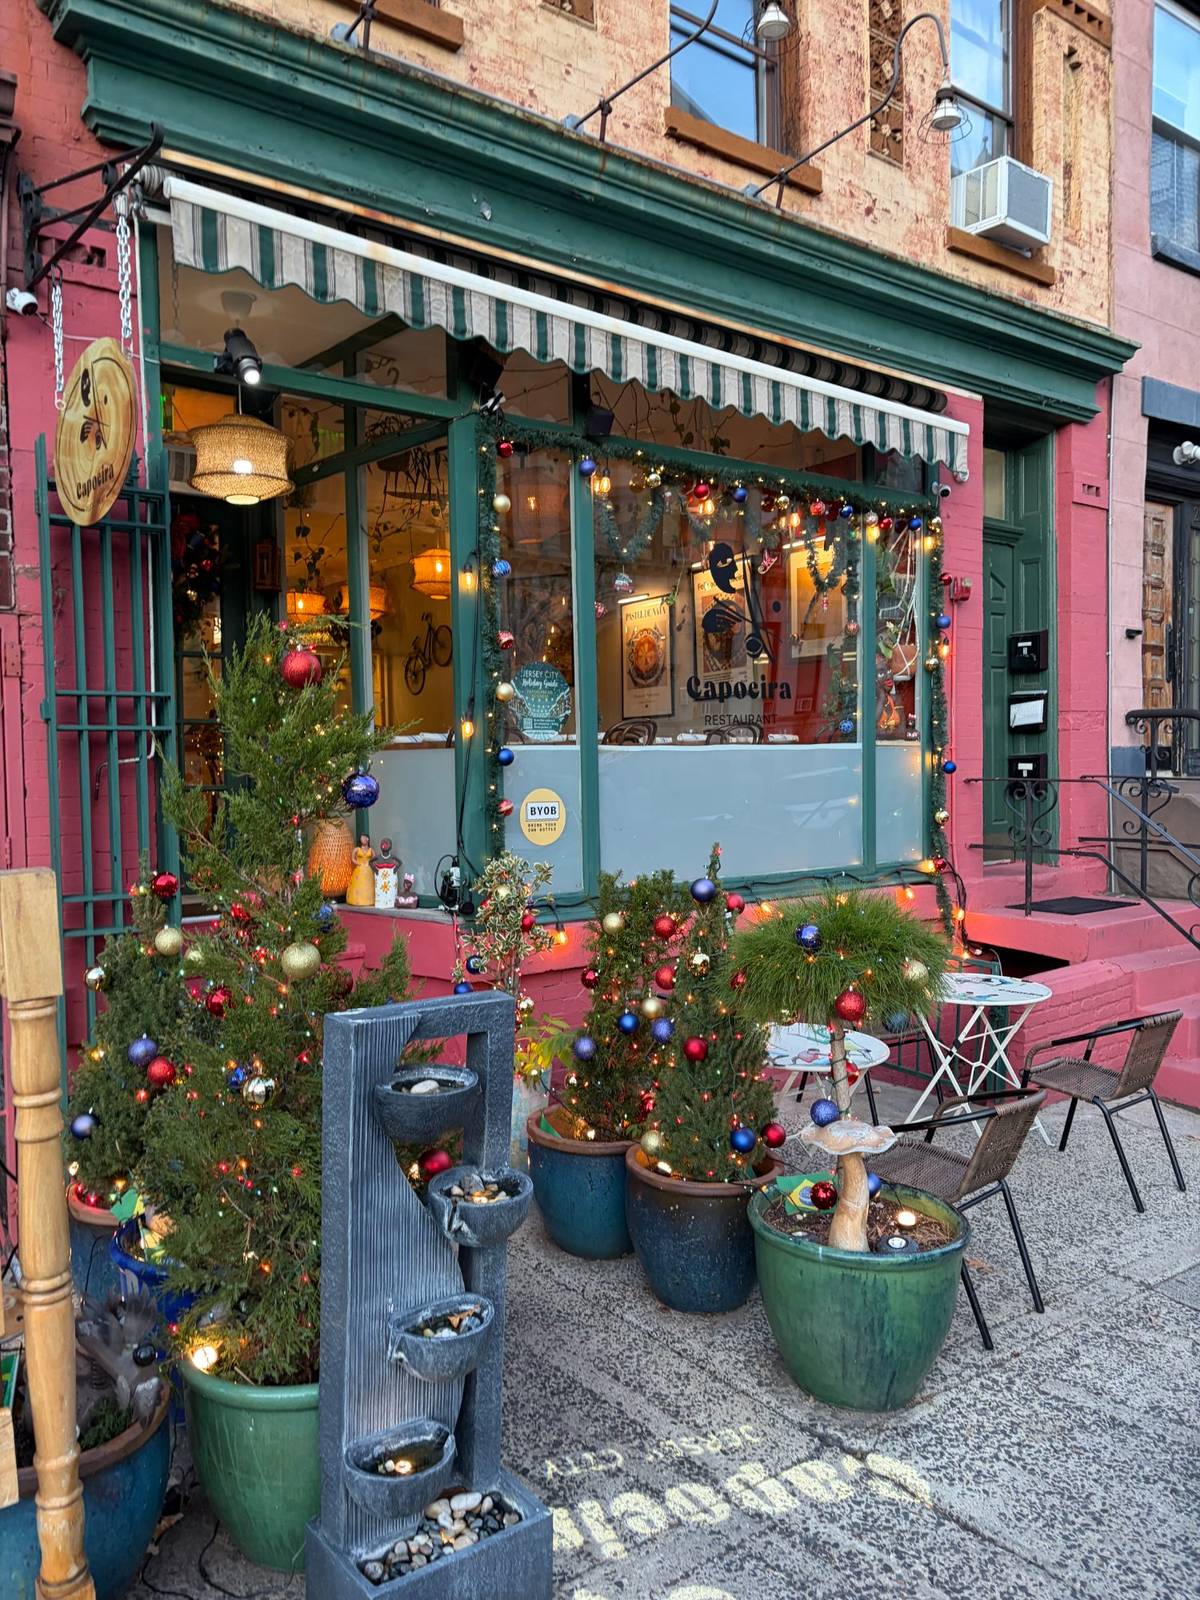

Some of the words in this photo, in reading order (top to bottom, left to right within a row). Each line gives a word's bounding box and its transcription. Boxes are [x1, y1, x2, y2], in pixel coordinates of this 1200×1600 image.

[76, 463, 114, 500] Capoeira
[522, 669, 543, 678] JERSEY
[544, 670, 559, 679] CITY
[686, 674, 792, 702] Capoeira
[704, 714, 777, 726] RESTAURANT
[530, 806, 557, 815] BYOB
[553, 1452, 931, 1560] Capoeir
